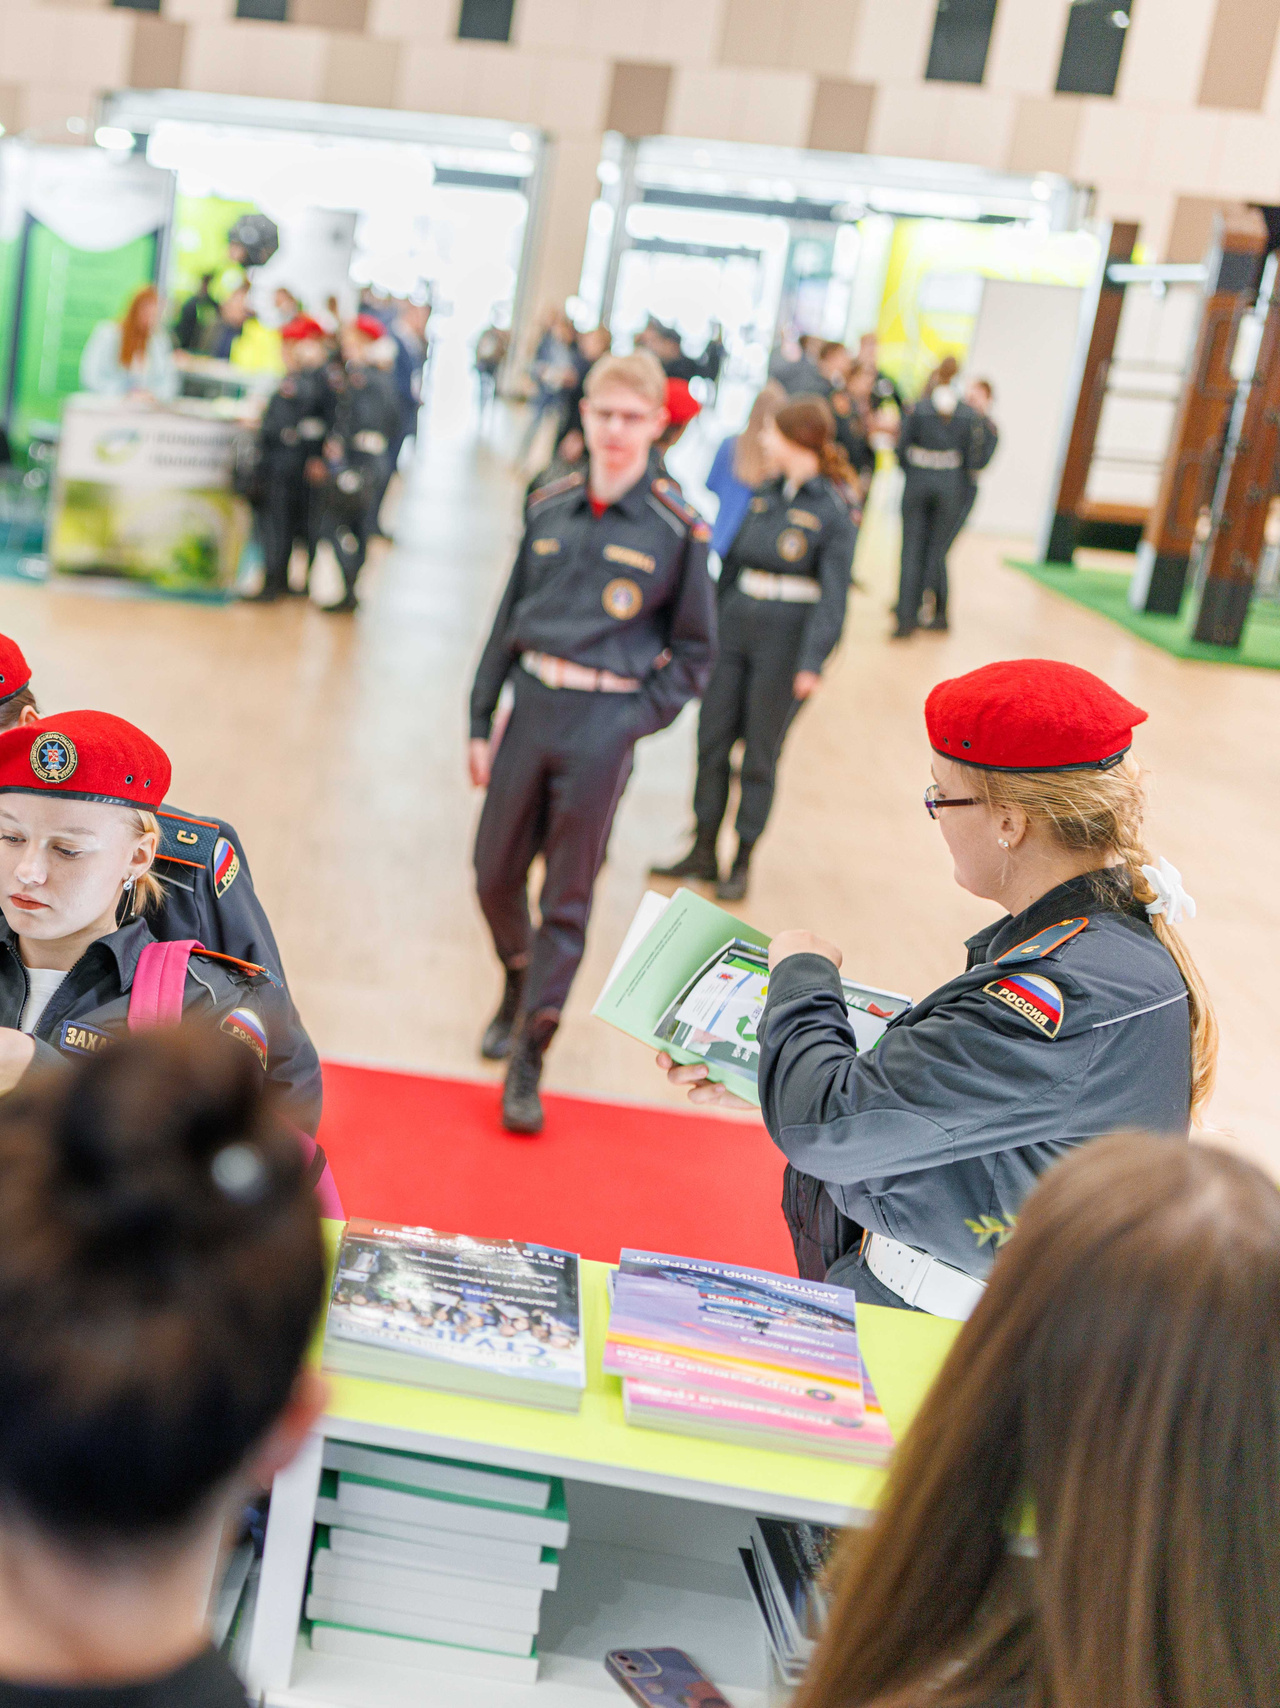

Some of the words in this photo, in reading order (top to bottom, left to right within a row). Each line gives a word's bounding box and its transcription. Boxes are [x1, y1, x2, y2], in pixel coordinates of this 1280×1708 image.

[998, 987, 1050, 1026] РОССИЯ
[553, 1255, 565, 1263] Я
[631, 1254, 719, 1274] ПЕТЕРБУРГ
[723, 1270, 838, 1299] АРКТИЧЕСКИЙ
